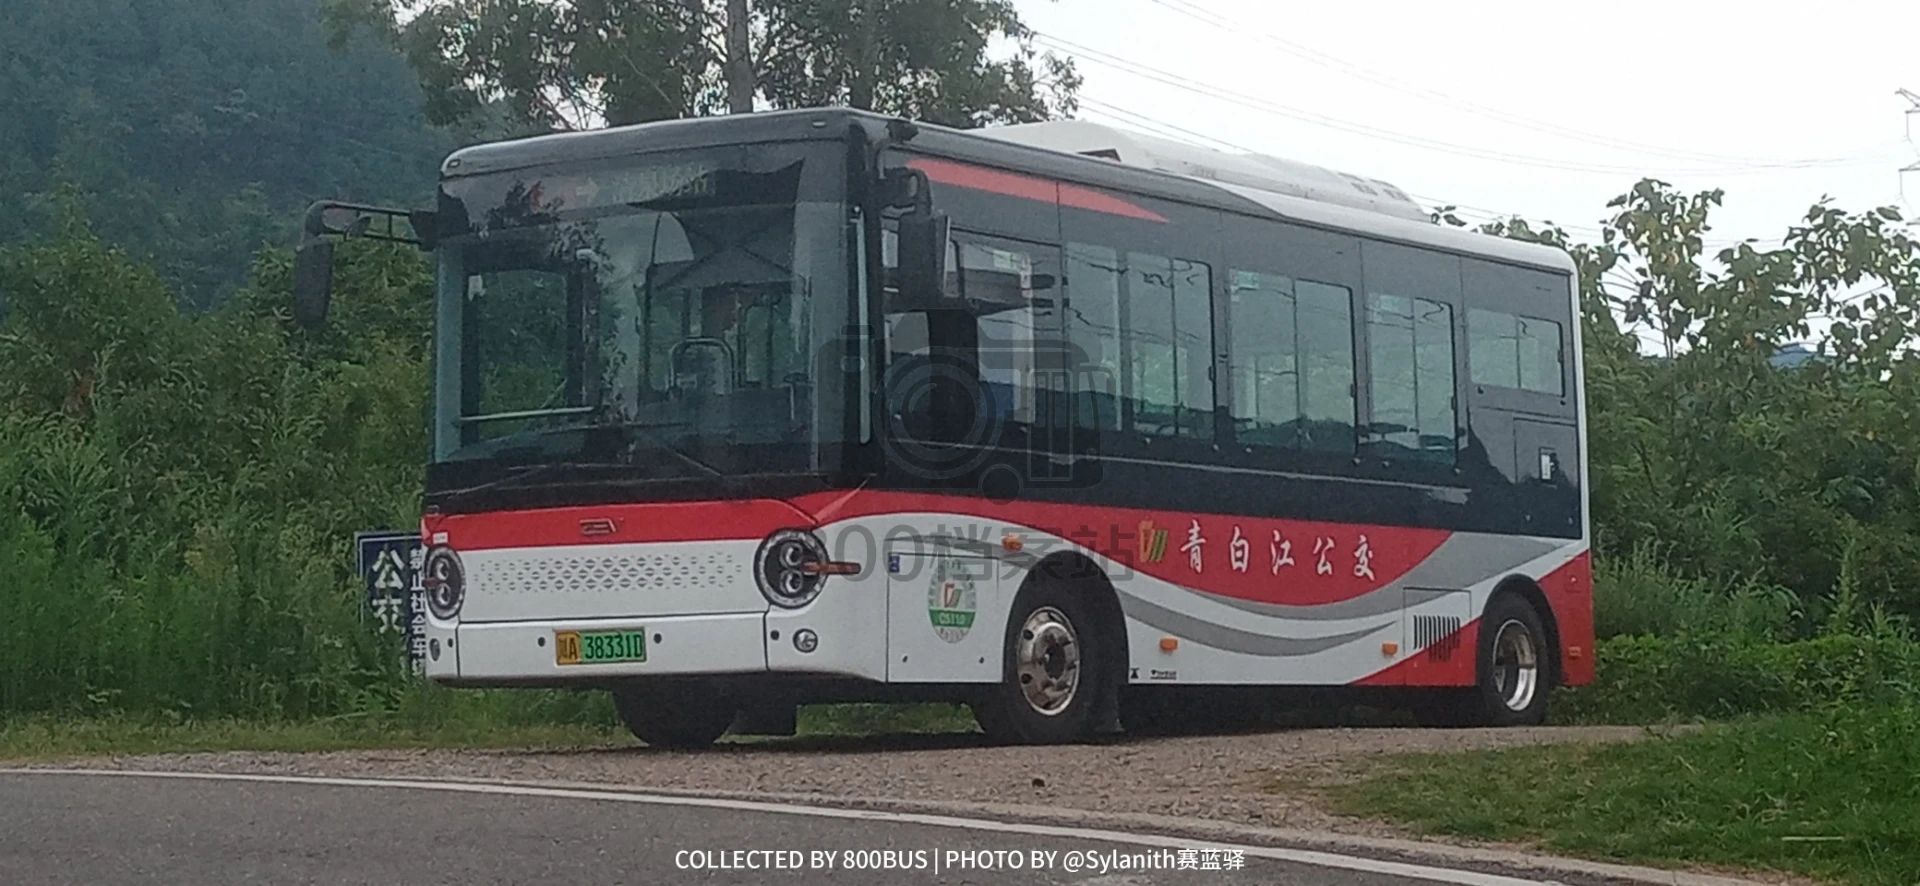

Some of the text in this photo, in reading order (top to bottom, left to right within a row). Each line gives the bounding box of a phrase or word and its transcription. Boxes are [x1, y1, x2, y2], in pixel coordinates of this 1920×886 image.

[1180, 519, 1375, 581] 青白江公交
